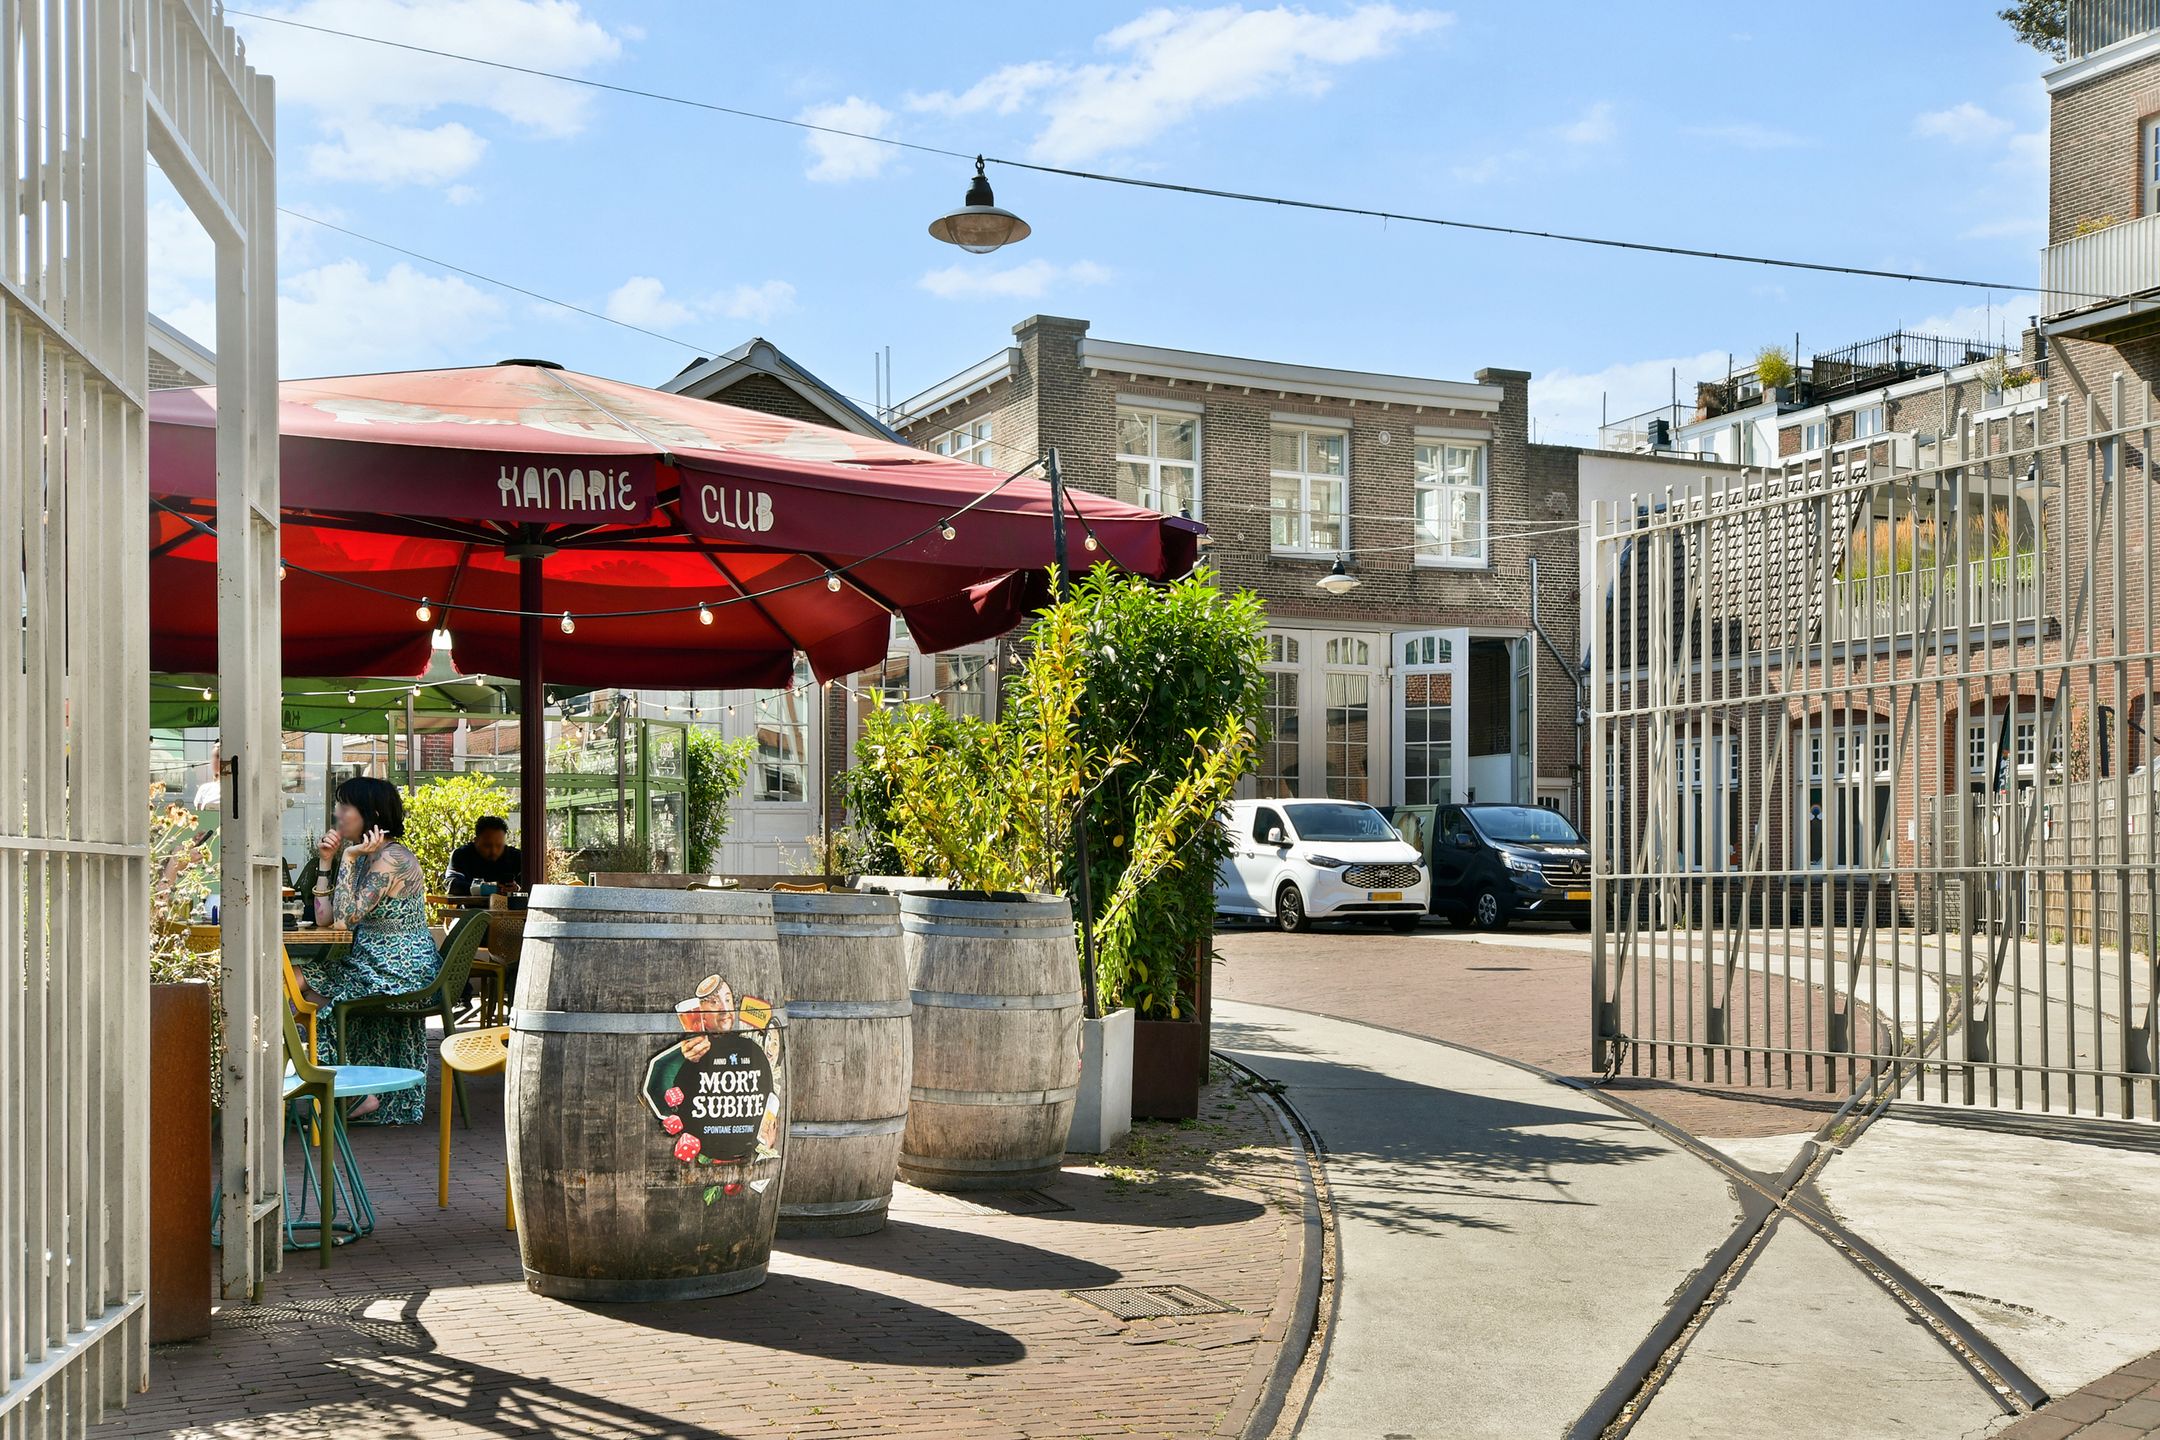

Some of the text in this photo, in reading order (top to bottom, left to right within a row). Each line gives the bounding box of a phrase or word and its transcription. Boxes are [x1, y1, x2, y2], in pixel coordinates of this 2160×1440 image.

[497, 465, 774, 533] KANARIE CLUB
[713, 1057, 727, 1066] ANNO
[698, 1069, 761, 1094] MORT
[691, 1093, 765, 1119] SUBITE
[703, 1125, 732, 1135] SPONTANE
